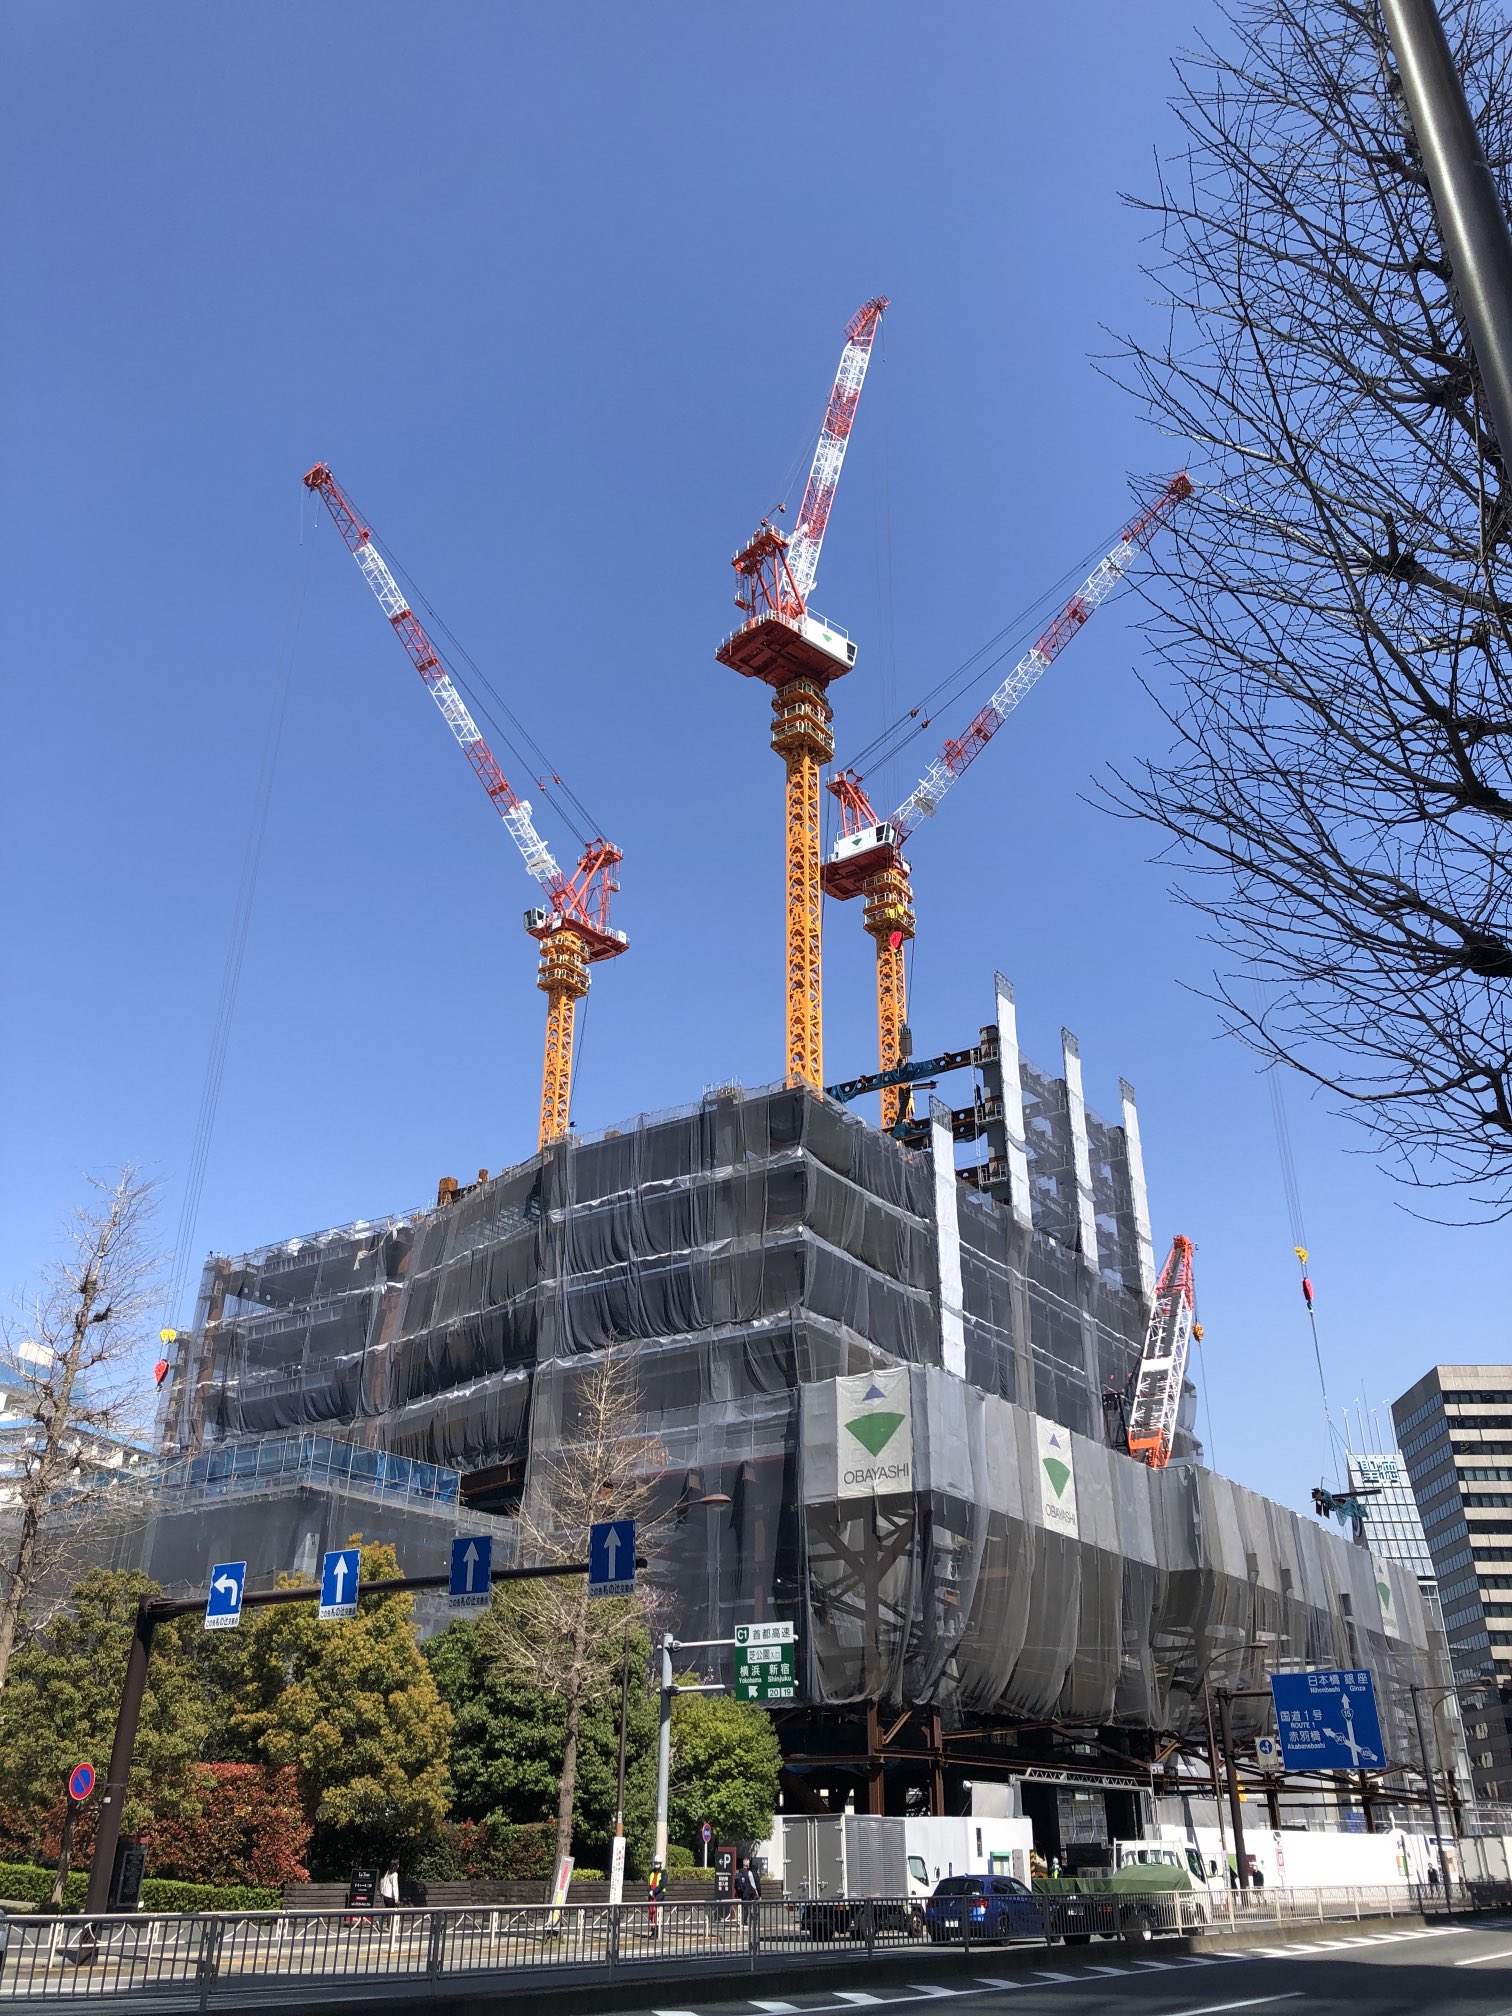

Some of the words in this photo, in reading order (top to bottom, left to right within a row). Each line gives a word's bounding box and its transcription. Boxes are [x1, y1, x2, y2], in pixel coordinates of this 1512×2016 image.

[843, 1462, 910, 1485] OBAYASHI
[1045, 1503, 1077, 1526] OBAYASHI
[737, 1629, 747, 1640] C1
[753, 1627, 790, 1640] 首都高速
[749, 1649, 780, 1661] 芝公園入口
[740, 1665, 760, 1677] 横浜
[769, 1663, 789, 1675] 新宿
[767, 1675, 792, 1683] Shinjuku
[1308, 1674, 1340, 1686] 日本橋
[1344, 1673, 1368, 1685] 銀座
[783, 1688, 791, 1696] 19
[1310, 1686, 1341, 1694] Nihonbashi
[1344, 1710, 1352, 1718] 15
[1289, 1730, 1321, 1742] 赤羽橋
[1287, 1742, 1326, 1750] Akabanebashi
[723, 1853, 731, 1869] P
